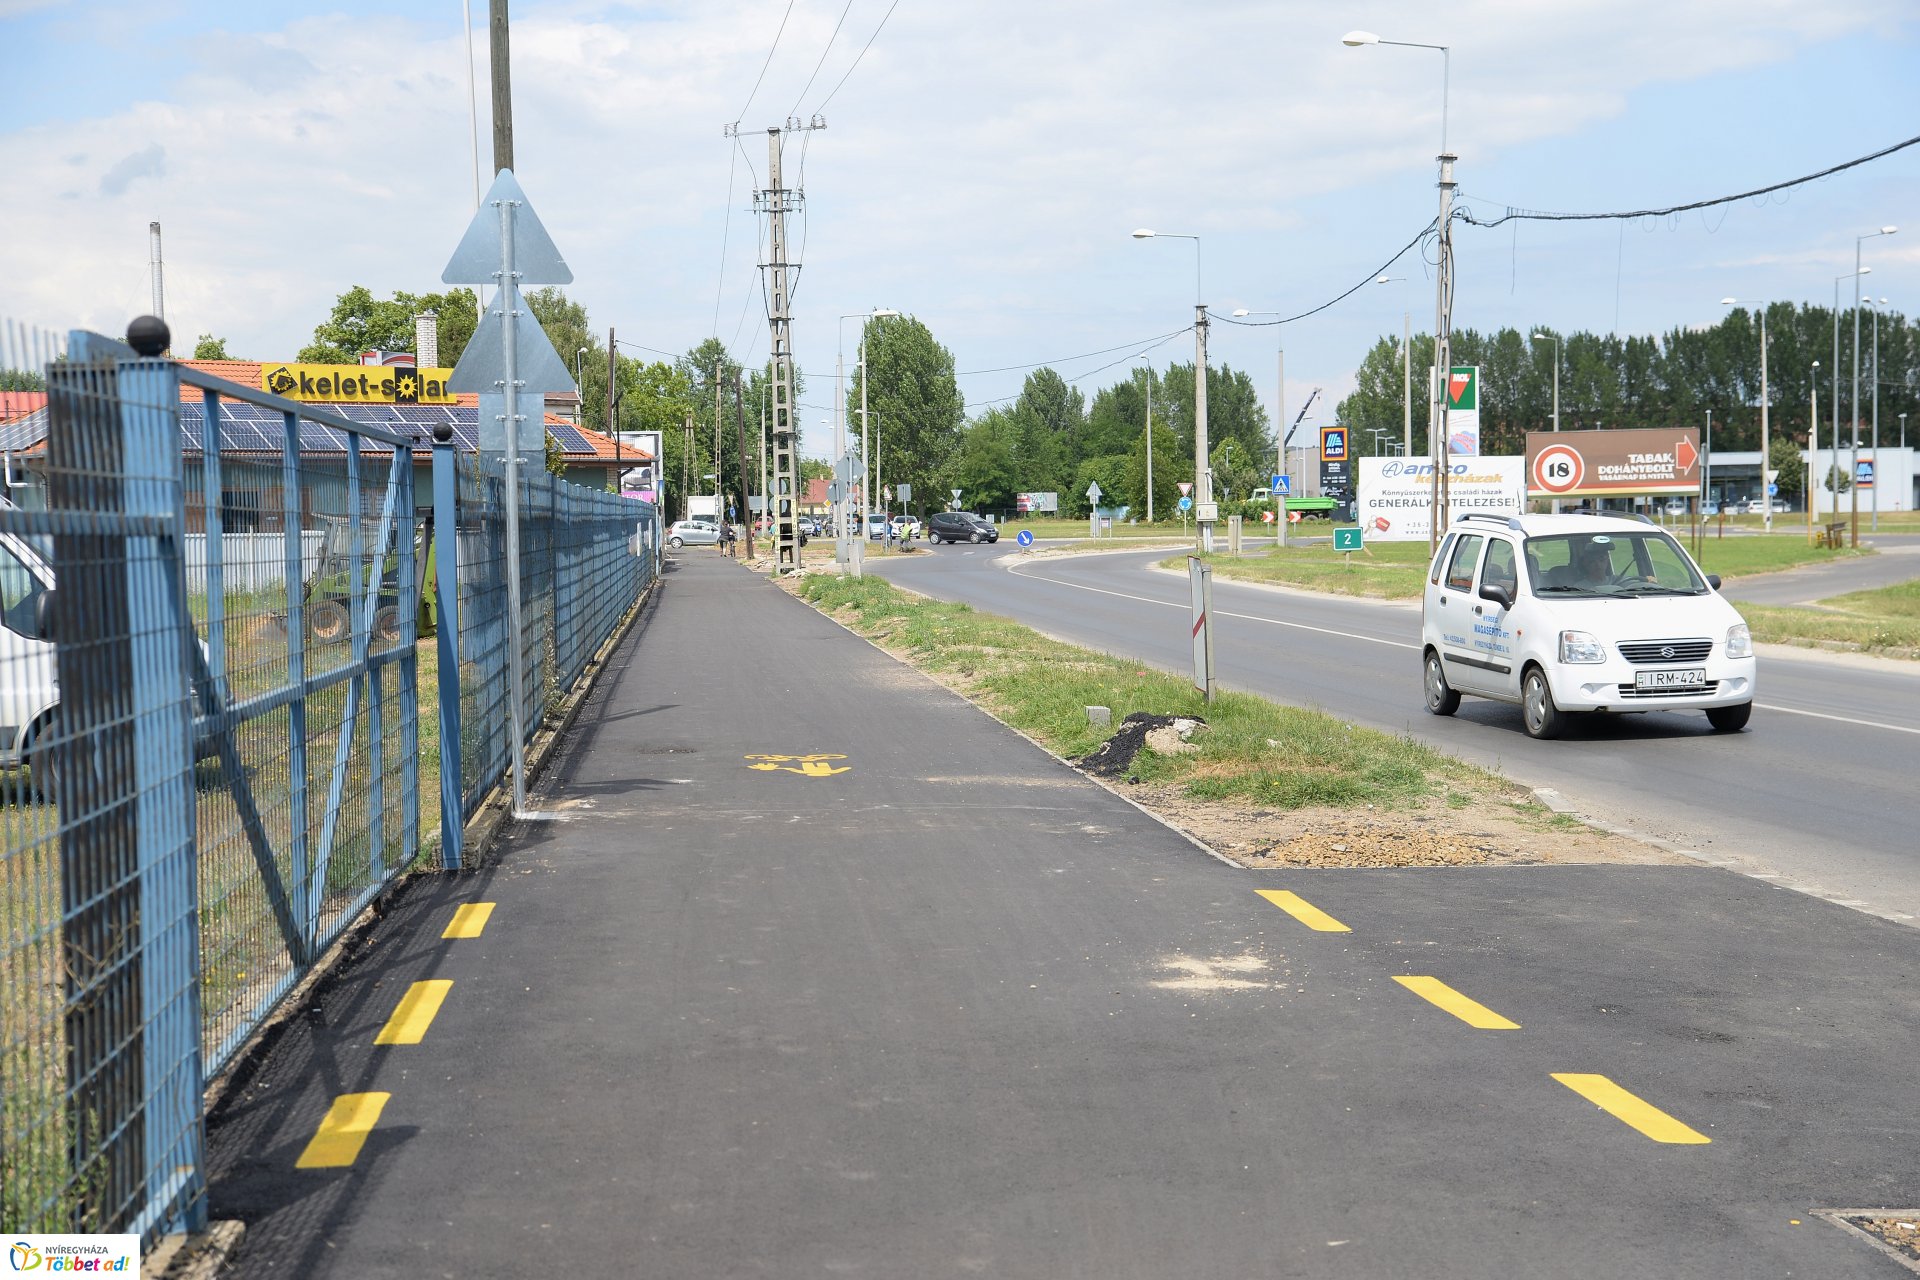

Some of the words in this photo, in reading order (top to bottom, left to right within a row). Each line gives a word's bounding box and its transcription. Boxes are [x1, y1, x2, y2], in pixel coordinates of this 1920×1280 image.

[1452, 373, 1469, 382] MOL
[1326, 447, 1343, 455] ALDI
[1628, 452, 1675, 464] TABAK,
[1548, 462, 1570, 478] 18
[1598, 463, 1675, 475] DOHÁNYBOLT
[1453, 488, 1480, 496] családi
[1344, 533, 1352, 545] 2
[1650, 671, 1703, 685] IRM-424
